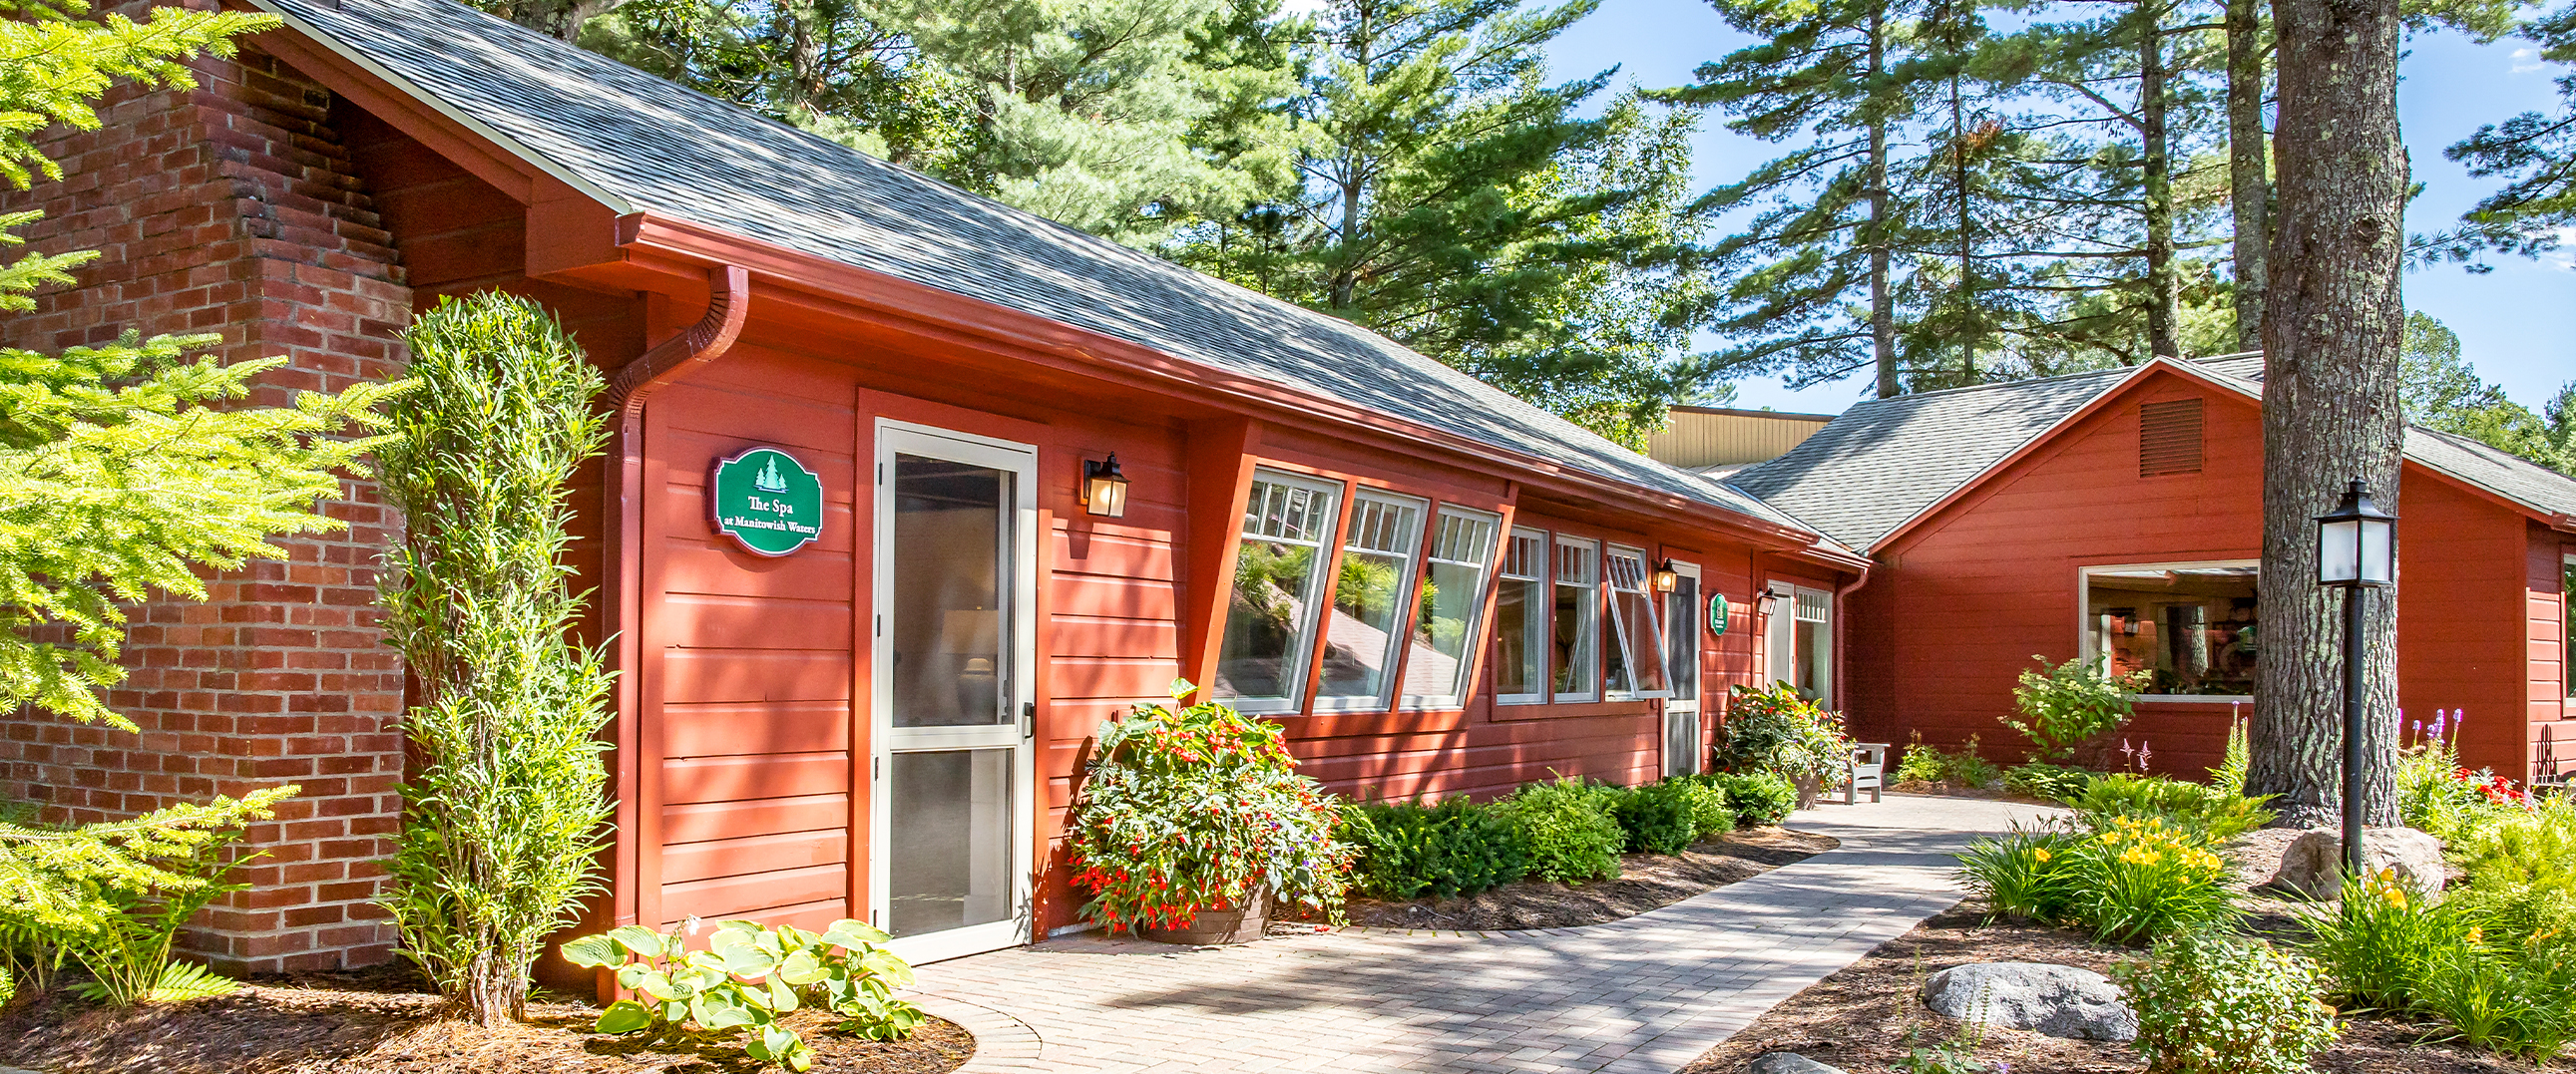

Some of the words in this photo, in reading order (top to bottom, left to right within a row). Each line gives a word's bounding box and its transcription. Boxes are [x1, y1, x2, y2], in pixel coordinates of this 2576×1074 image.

[748, 496, 769, 512] The
[772, 499, 793, 518] Spa
[724, 517, 733, 526] at
[734, 516, 786, 532] Manitowish
[787, 521, 816, 535] Waters
